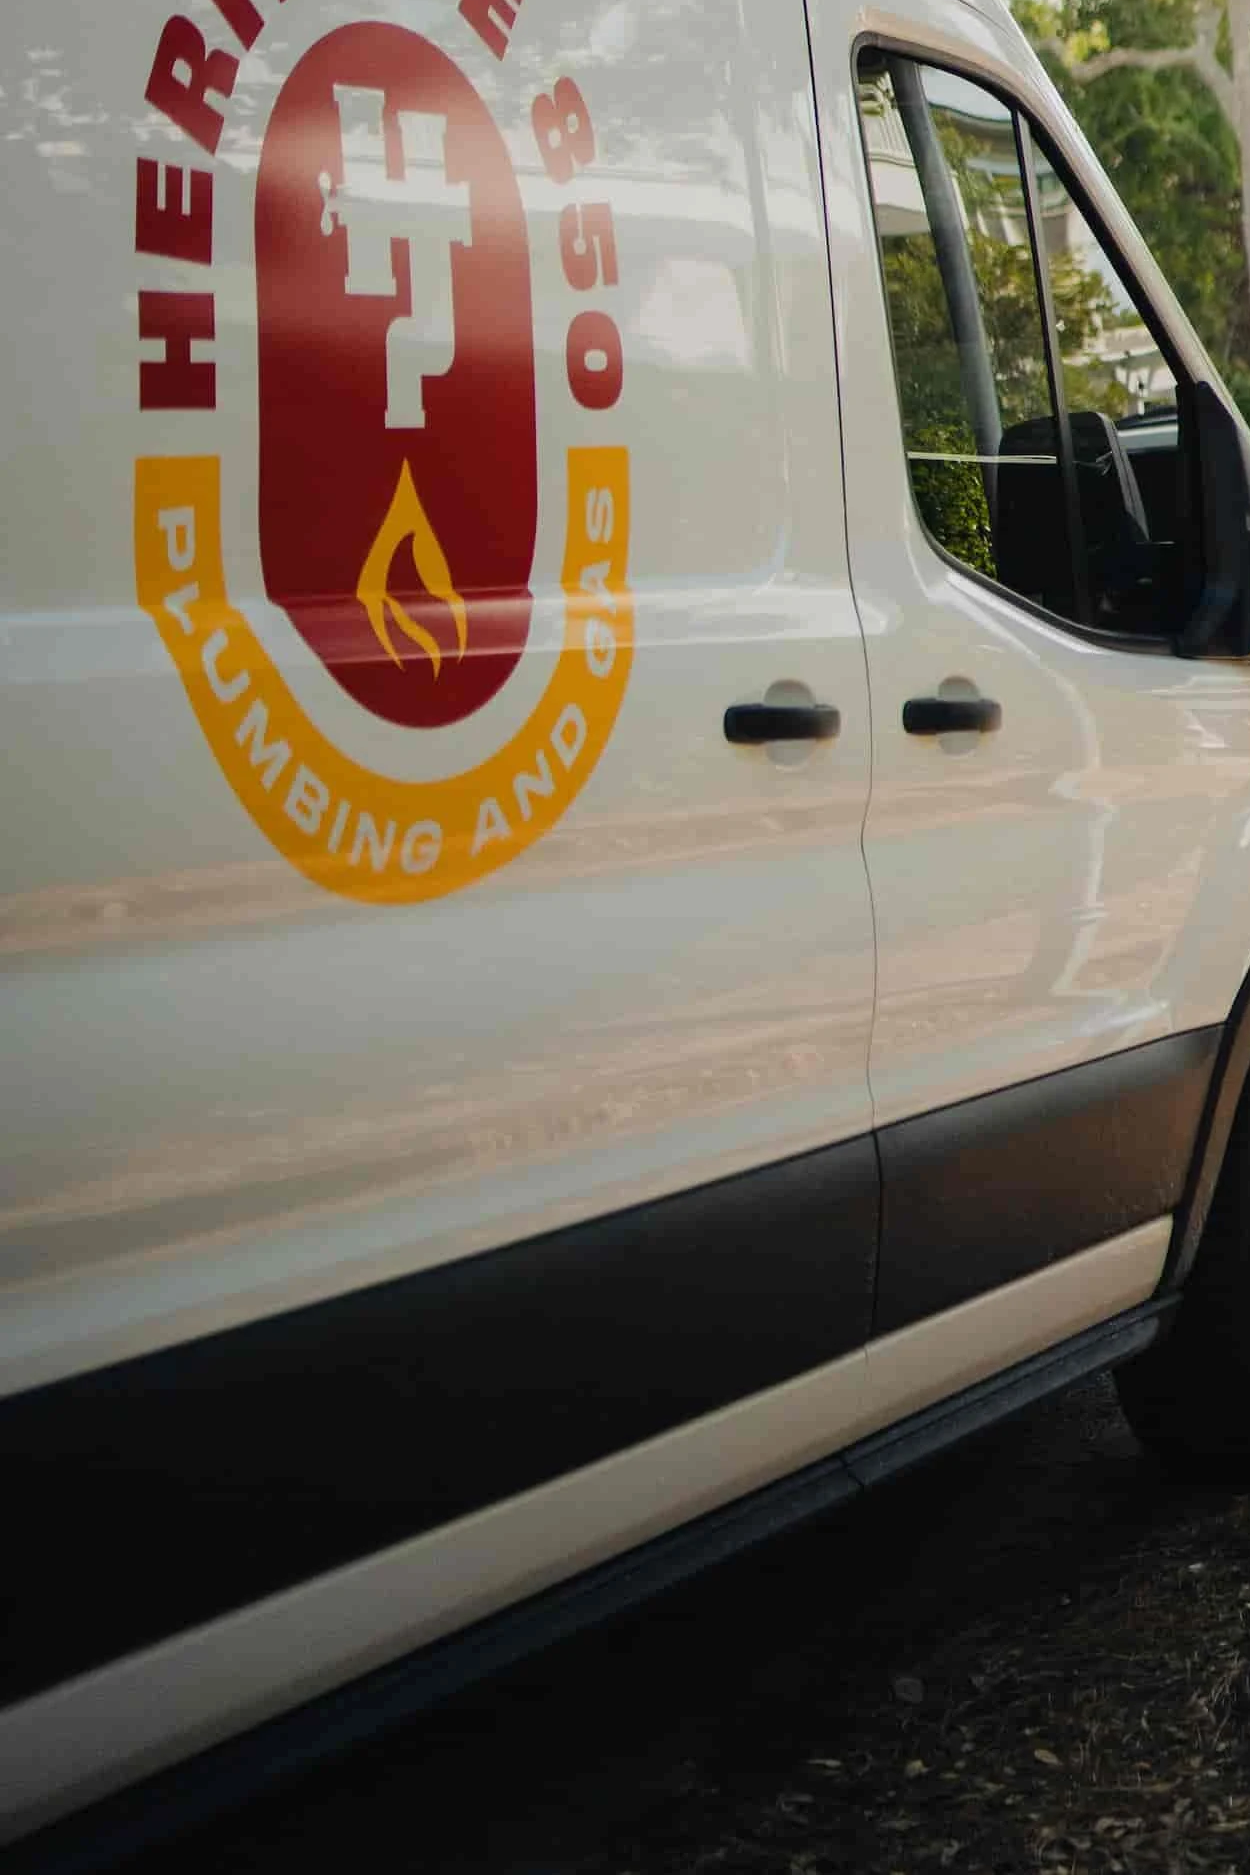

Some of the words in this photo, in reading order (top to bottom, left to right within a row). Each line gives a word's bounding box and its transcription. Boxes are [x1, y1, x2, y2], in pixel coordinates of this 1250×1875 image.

[529, 75, 625, 412] 850
[157, 505, 444, 875] PLUMBING
[470, 702, 588, 858] AND
[582, 486, 617, 680] GAS
